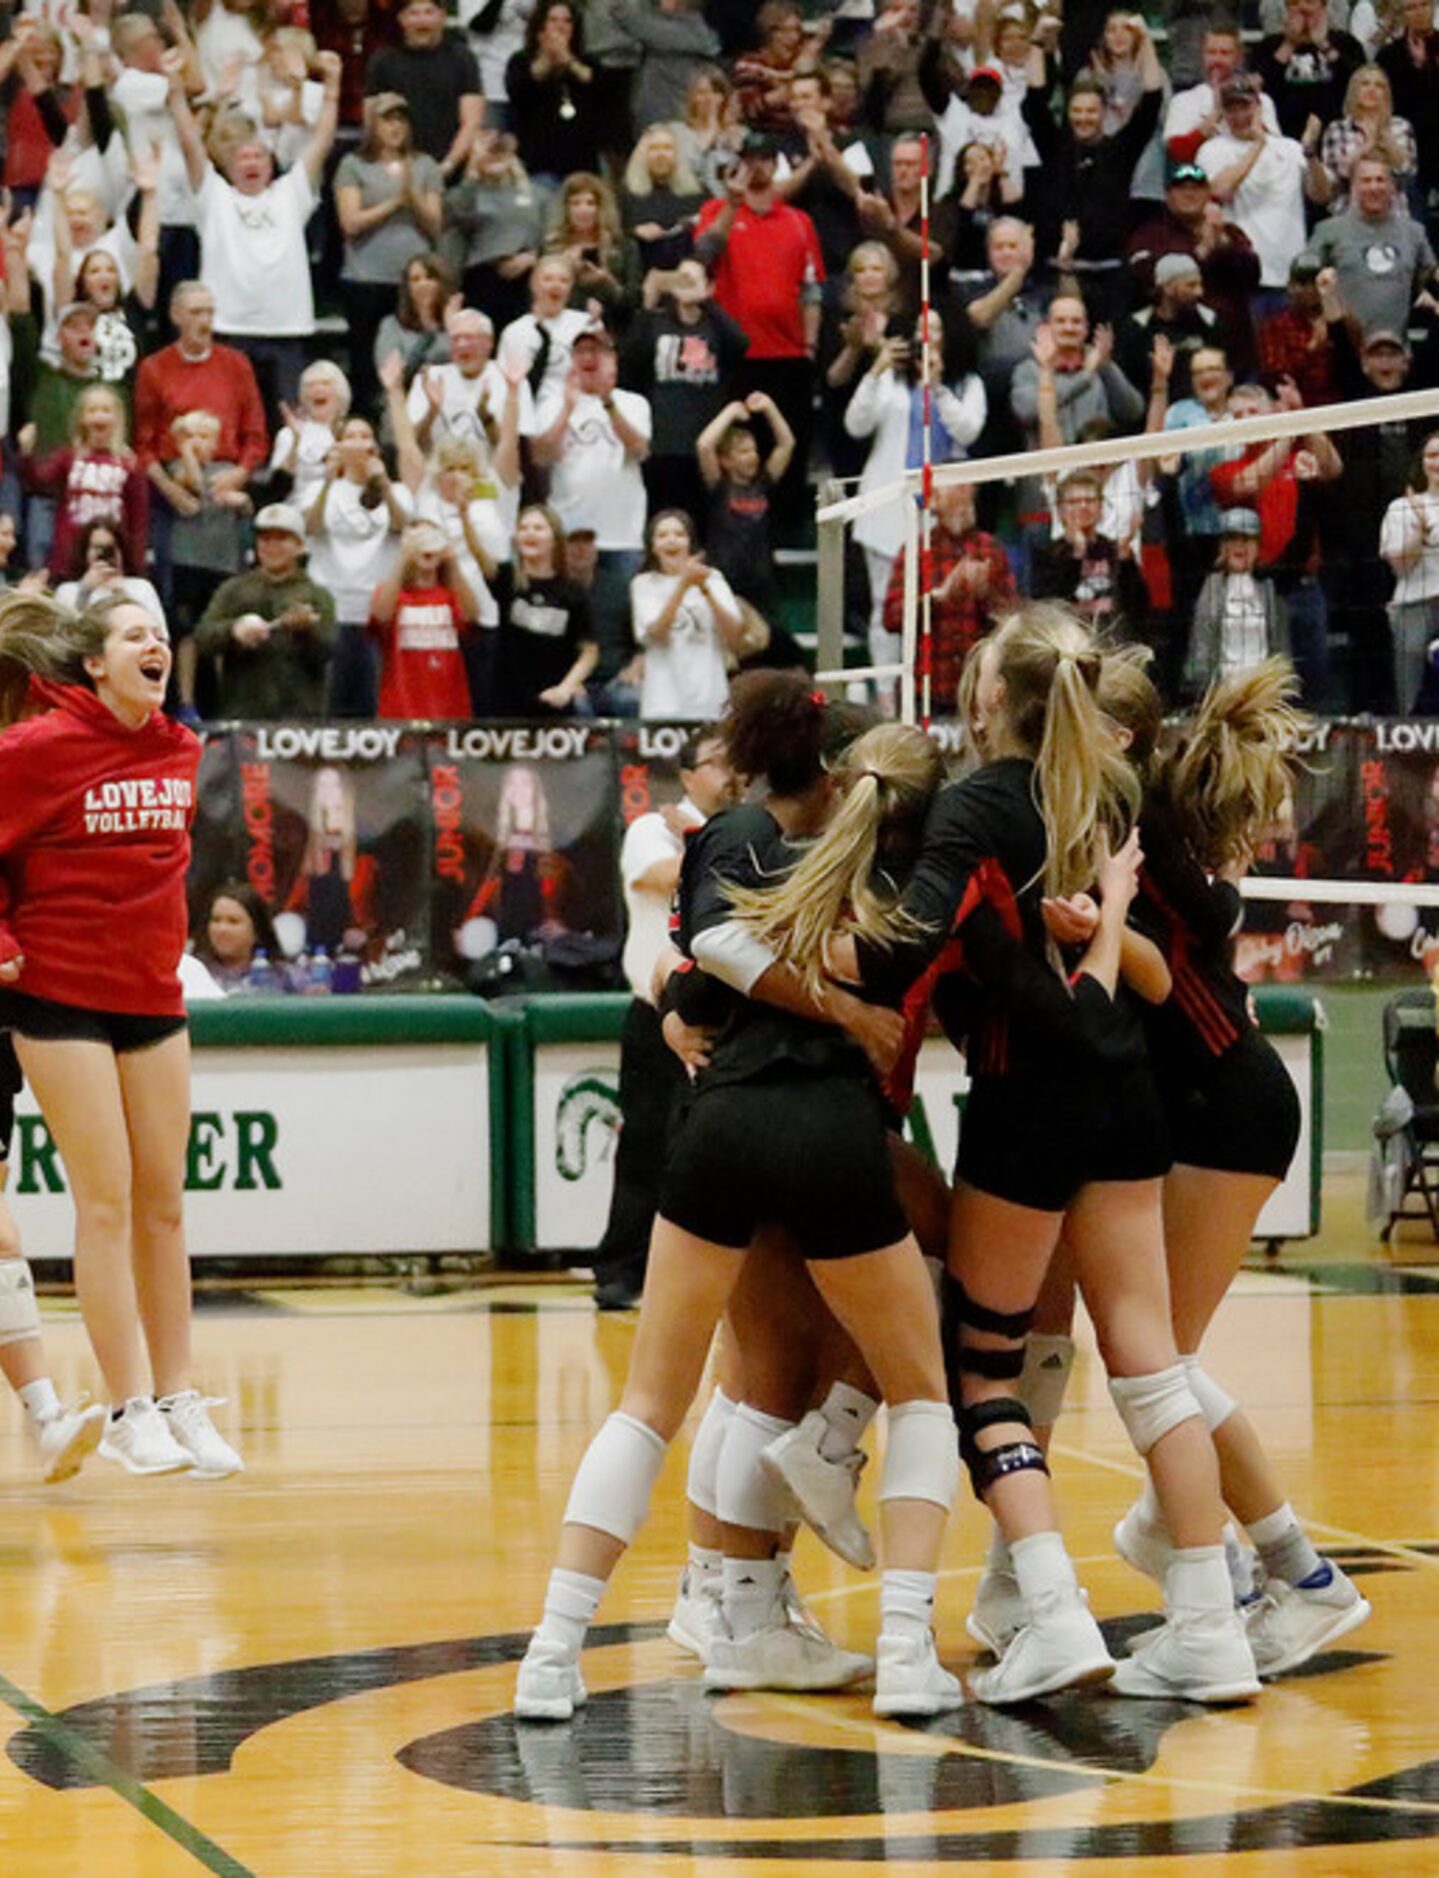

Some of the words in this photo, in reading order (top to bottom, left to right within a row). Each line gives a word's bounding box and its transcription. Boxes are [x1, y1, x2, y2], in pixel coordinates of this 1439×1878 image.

[257, 727, 401, 759] LOVEJOY
[447, 727, 590, 759] LOVEJOY
[432, 764, 466, 884] JUNIOR
